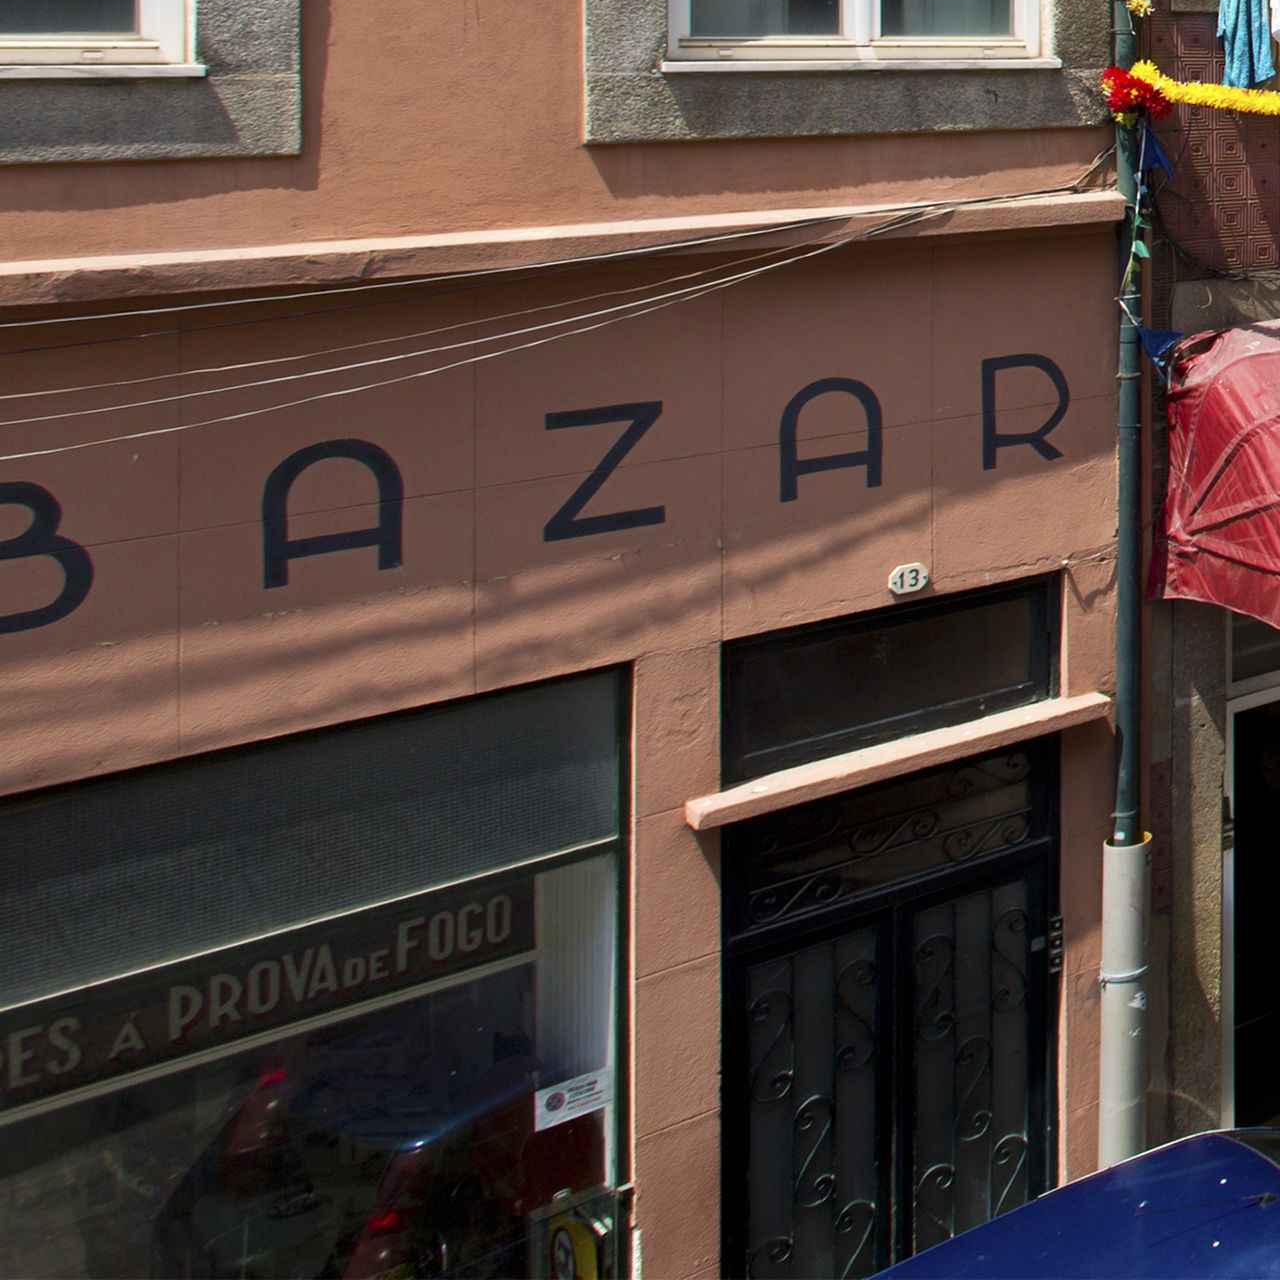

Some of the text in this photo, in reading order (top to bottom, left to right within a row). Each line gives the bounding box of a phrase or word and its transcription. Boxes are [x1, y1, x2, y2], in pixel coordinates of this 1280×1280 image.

[0, 354, 1069, 634] BAZAR
[899, 568, 919, 590] 13
[0, 1016, 82, 1089] ES
[167, 942, 339, 1042] PROVA
[342, 948, 391, 989] DE
[396, 893, 514, 973] FOGO
